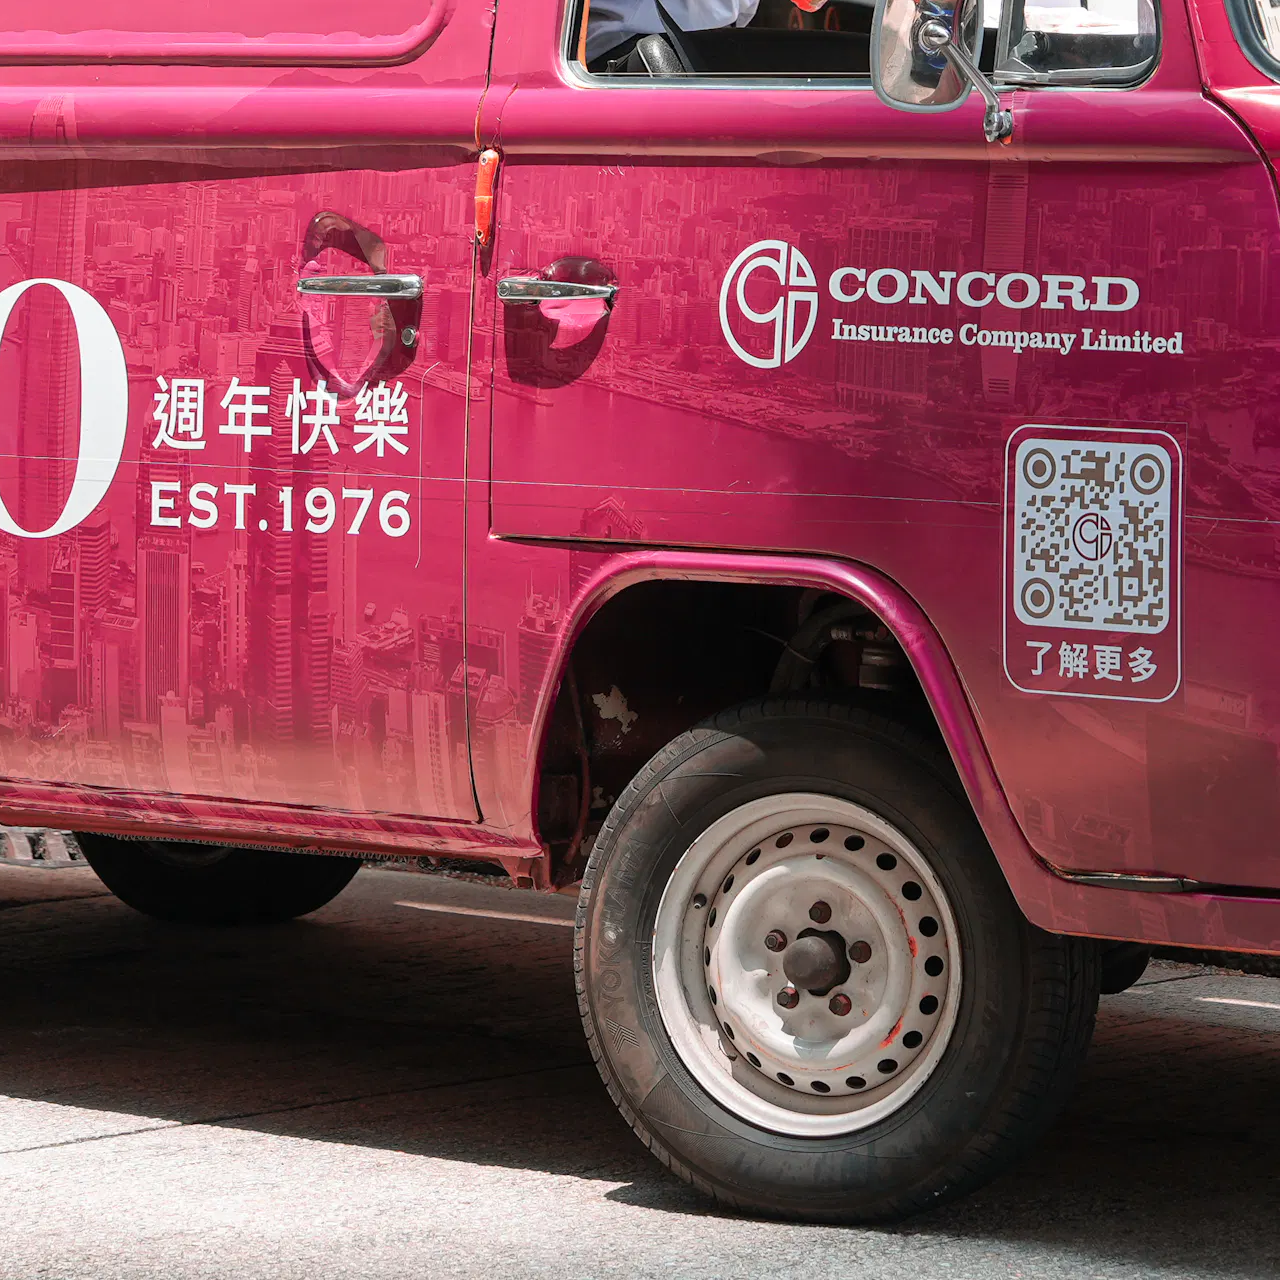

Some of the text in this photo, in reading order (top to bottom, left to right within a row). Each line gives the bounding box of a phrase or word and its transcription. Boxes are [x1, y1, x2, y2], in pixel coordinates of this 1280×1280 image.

[827, 266, 1140, 311] CONCORD
[830, 318, 1184, 355] Insurance Company Limited
[151, 375, 410, 458] 週年快樂
[149, 480, 411, 538] EST.1976
[1025, 641, 1158, 683] 了解更多
[597, 837, 651, 1009] YOKOHAMA
